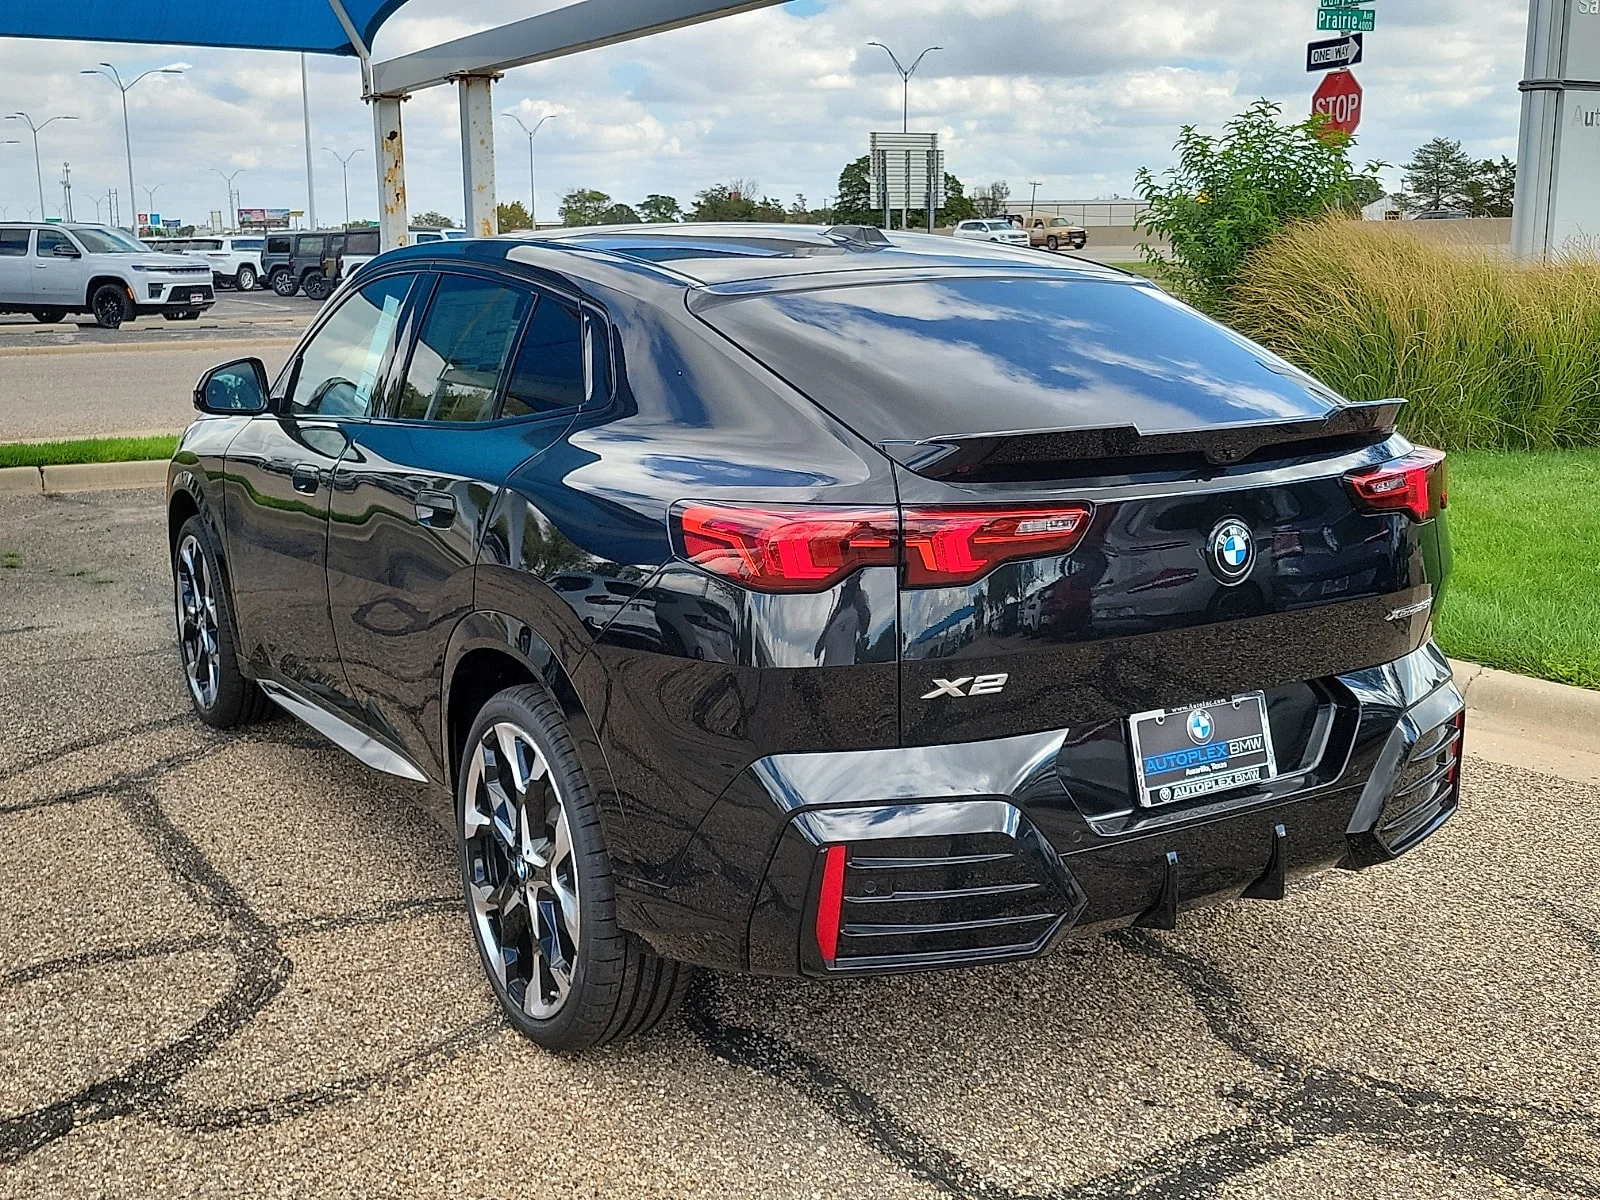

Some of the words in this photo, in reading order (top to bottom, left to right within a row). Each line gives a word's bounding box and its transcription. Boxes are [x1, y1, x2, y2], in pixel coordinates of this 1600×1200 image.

[1318, 10, 1358, 29] Prairie
[1362, 10, 1373, 20] Ave
[1313, 49, 1331, 63] ONE
[1334, 45, 1350, 59] WAY
[1315, 93, 1359, 123] STOP
[1218, 526, 1249, 544] BMW
[920, 673, 1009, 700] X2
[1145, 743, 1228, 772] AUTOPLEX
[1228, 737, 1263, 755] BMW
[1211, 762, 1228, 772] Texas
[1173, 776, 1235, 796] AUTOPLEX
[1234, 769, 1261, 783] BMW
